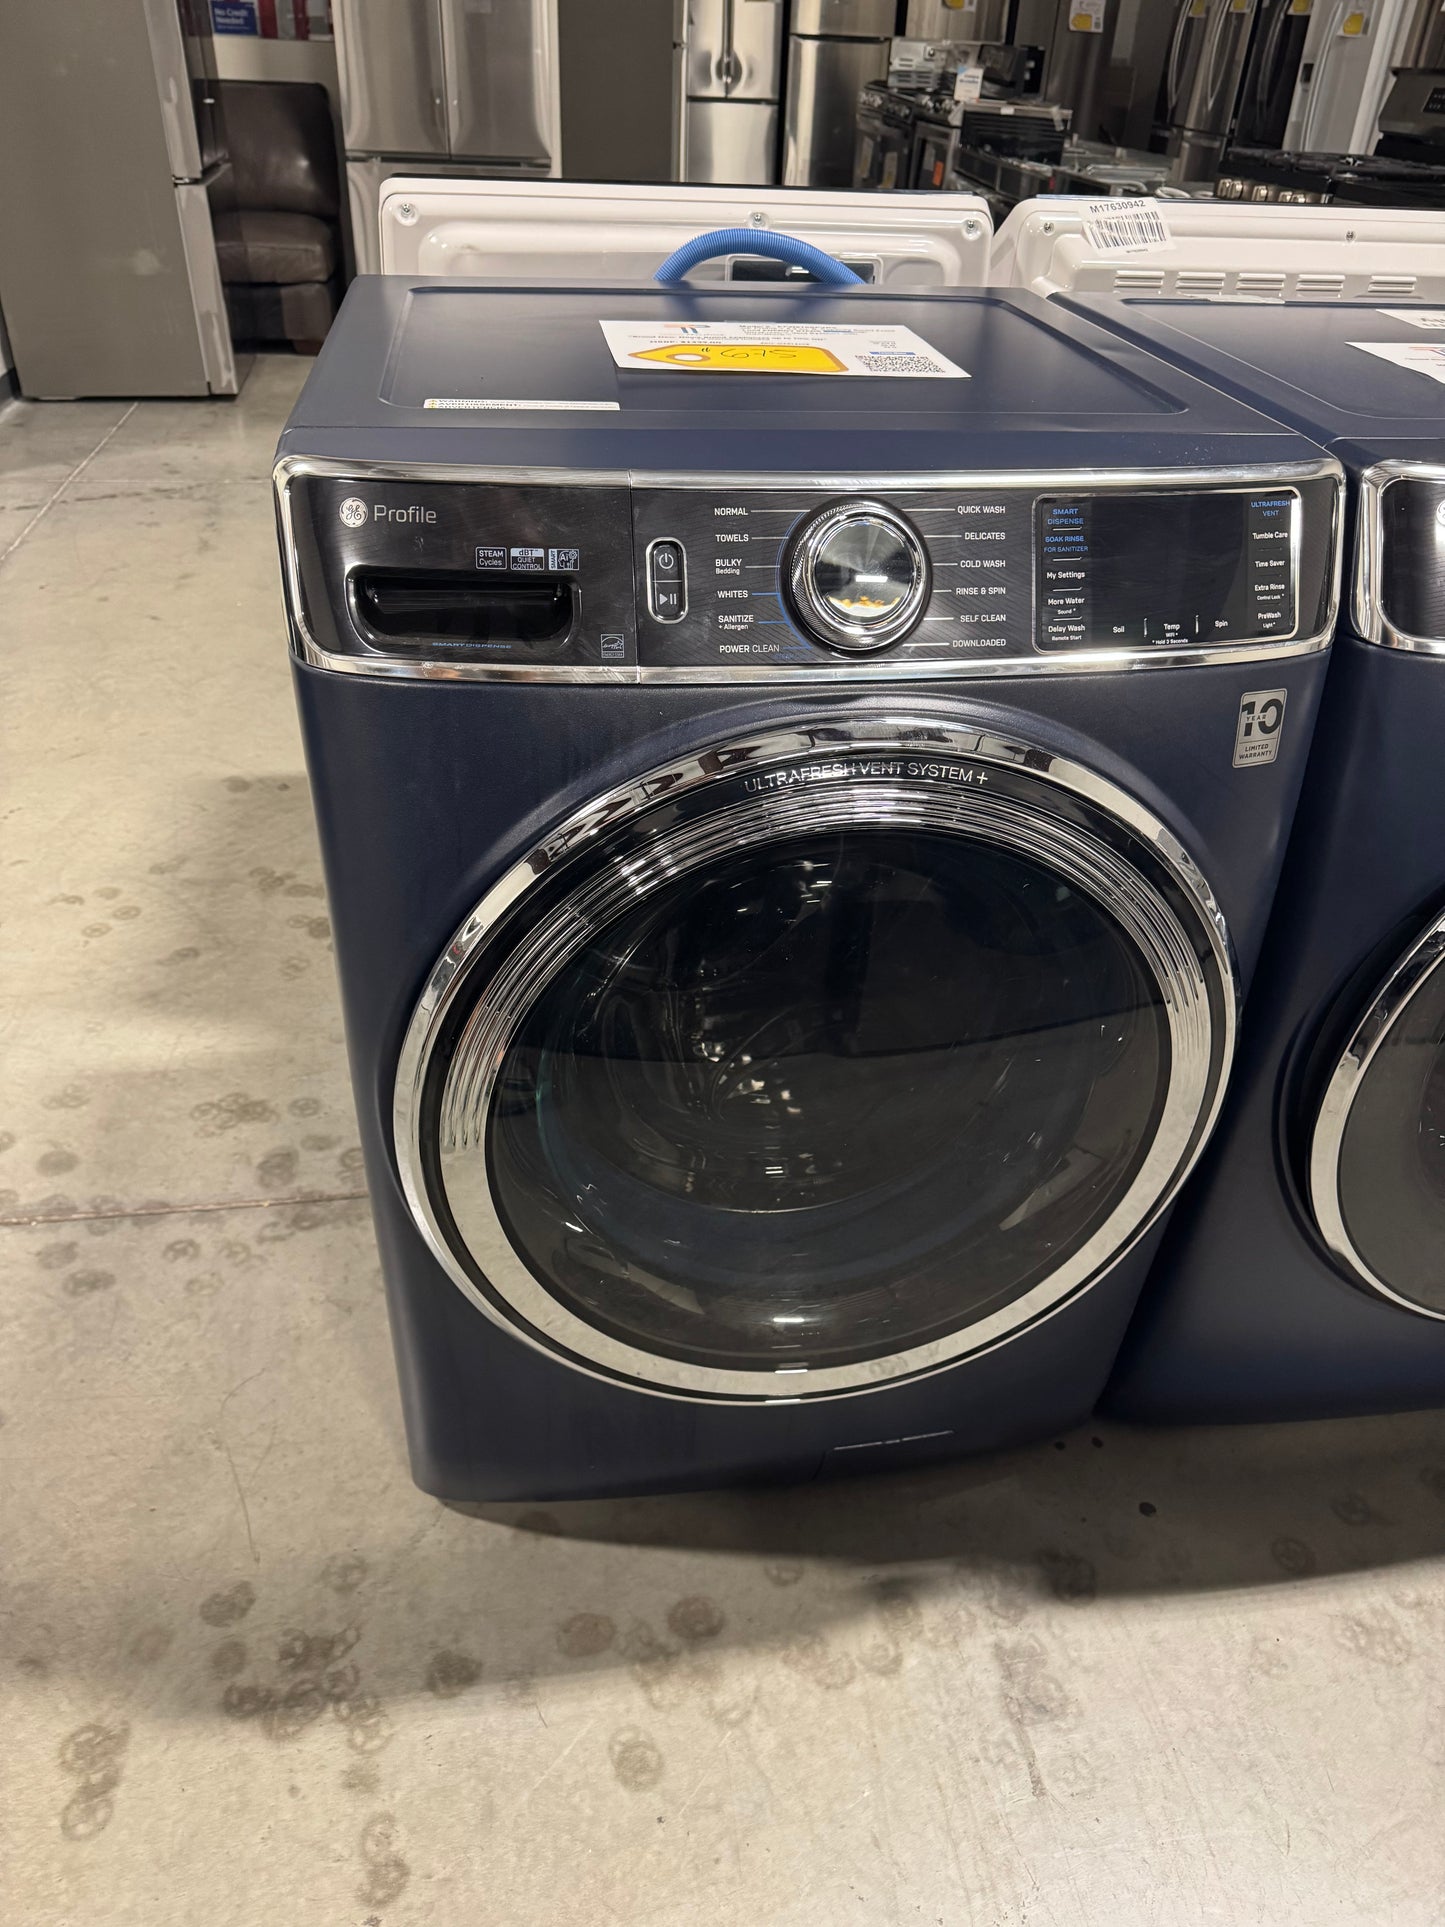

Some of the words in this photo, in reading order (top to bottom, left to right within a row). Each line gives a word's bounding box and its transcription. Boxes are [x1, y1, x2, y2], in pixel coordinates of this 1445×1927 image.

[1090, 200, 1146, 213] M17630942
[374, 504, 437, 524] Profile
[714, 507, 748, 516] NORMAL
[957, 505, 981, 515] QUICK
[982, 505, 1006, 514] WASH
[715, 534, 749, 542] TOWELS
[964, 532, 1006, 540] DELICATES
[479, 549, 504, 557] STEAM
[479, 558, 502, 566] Cycles
[715, 558, 742, 567] BULKY
[960, 560, 981, 568] COLD
[982, 560, 1006, 568] WASH
[715, 567, 740, 575] Bedding
[1047, 572, 1057, 580] My
[1057, 571, 1085, 579] Settings
[717, 590, 748, 598] WHITES
[956, 587, 979, 595] RINSE
[980, 587, 987, 595] &
[988, 587, 1006, 595] SPIN
[1048, 598, 1064, 606] More
[1065, 597, 1085, 605] Water
[718, 614, 754, 623] SANITIZE
[960, 614, 980, 623] SELF
[980, 614, 1006, 622] CLEAN
[724, 623, 749, 631] Allergen
[1048, 625, 1067, 633] Delay
[1067, 624, 1085, 632] Wash
[1164, 623, 1181, 631] Temp
[1214, 620, 1228, 628] Spin
[952, 638, 1007, 648] DOWNLOADED
[719, 644, 750, 653] POWER
[752, 644, 780, 653] CLEAN
[1242, 698, 1284, 737] 10
[1245, 743, 1269, 752] LIMITED
[1239, 750, 1272, 760] WARRANTY
[744, 762, 856, 793] ULTRAFRESH
[860, 762, 904, 775] VENT
[907, 762, 974, 782] SYSTEM
